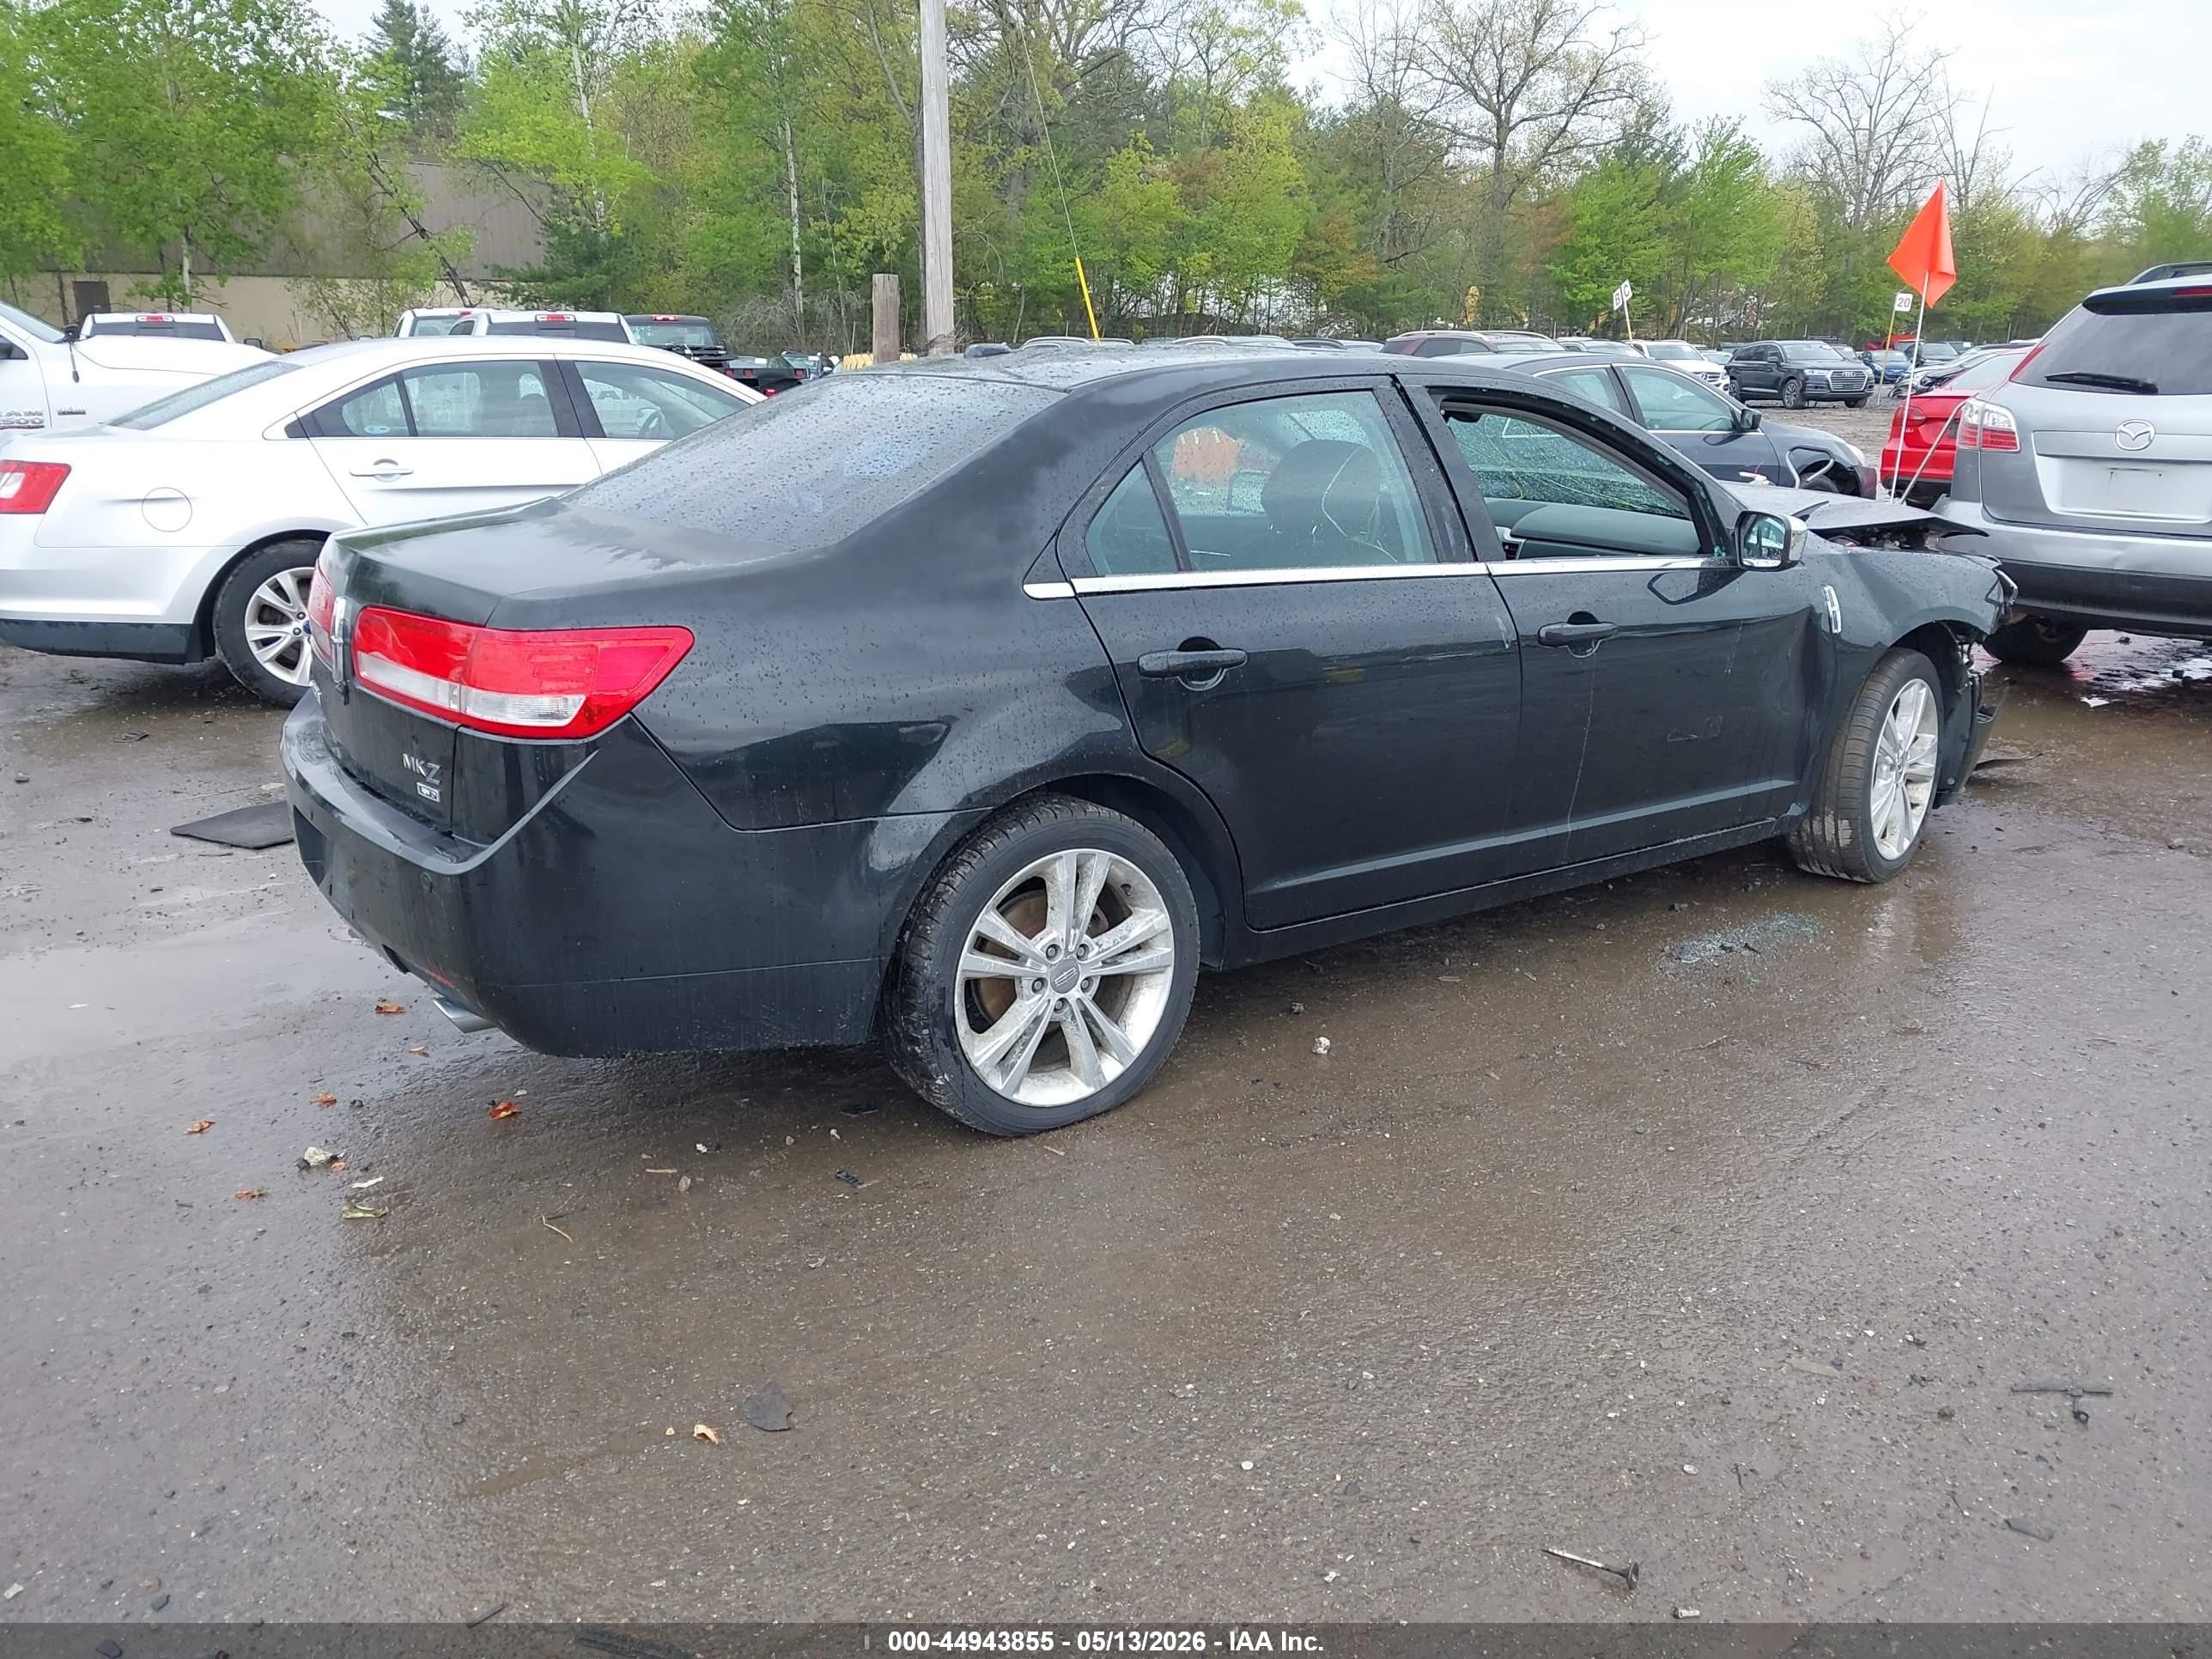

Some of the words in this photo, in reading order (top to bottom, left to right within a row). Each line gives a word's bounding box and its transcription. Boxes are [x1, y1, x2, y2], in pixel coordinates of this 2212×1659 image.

[1623, 284, 1630, 297] C
[1614, 293, 1621, 307] B
[1896, 296, 1911, 308] 20
[402, 752, 441, 786] MKZ
